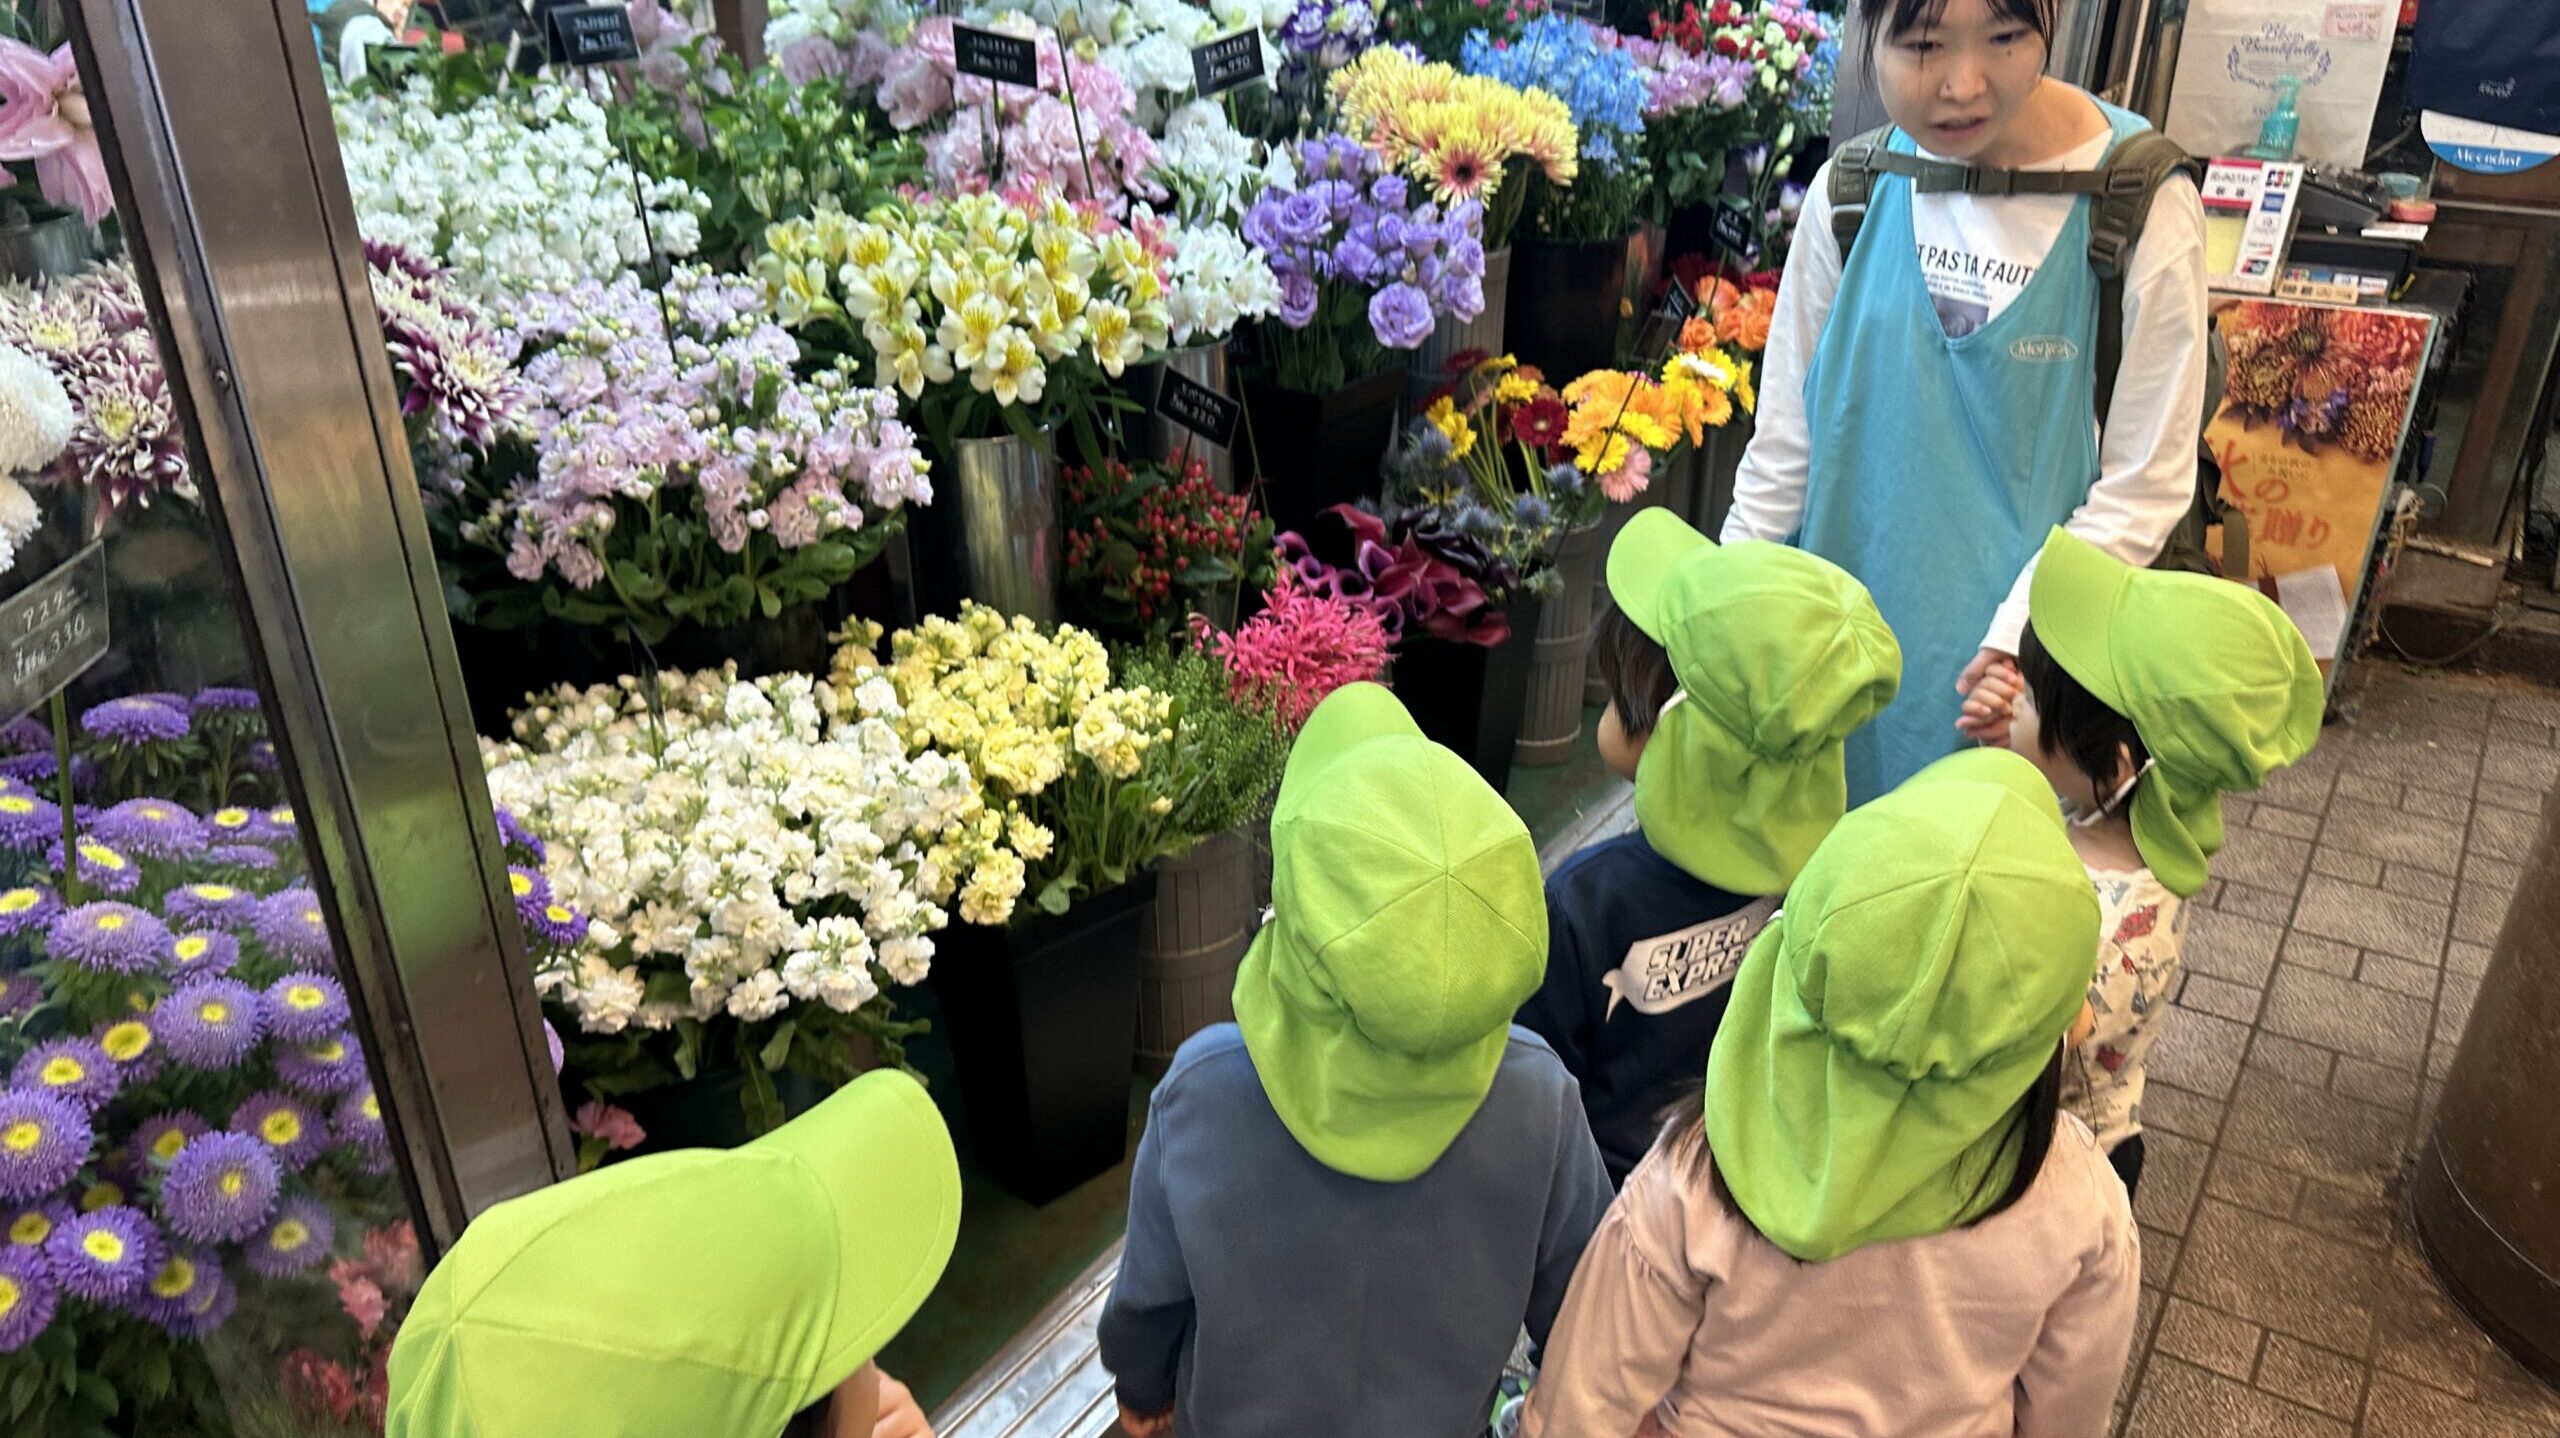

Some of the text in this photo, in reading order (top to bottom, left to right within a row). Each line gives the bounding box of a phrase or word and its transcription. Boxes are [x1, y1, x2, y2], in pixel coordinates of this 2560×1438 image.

[1926, 245, 1961, 271] PAS
[1982, 258, 2036, 287] FAUT
[1649, 918, 1748, 970] SUPER
[1644, 945, 1745, 1001] EXPRE
